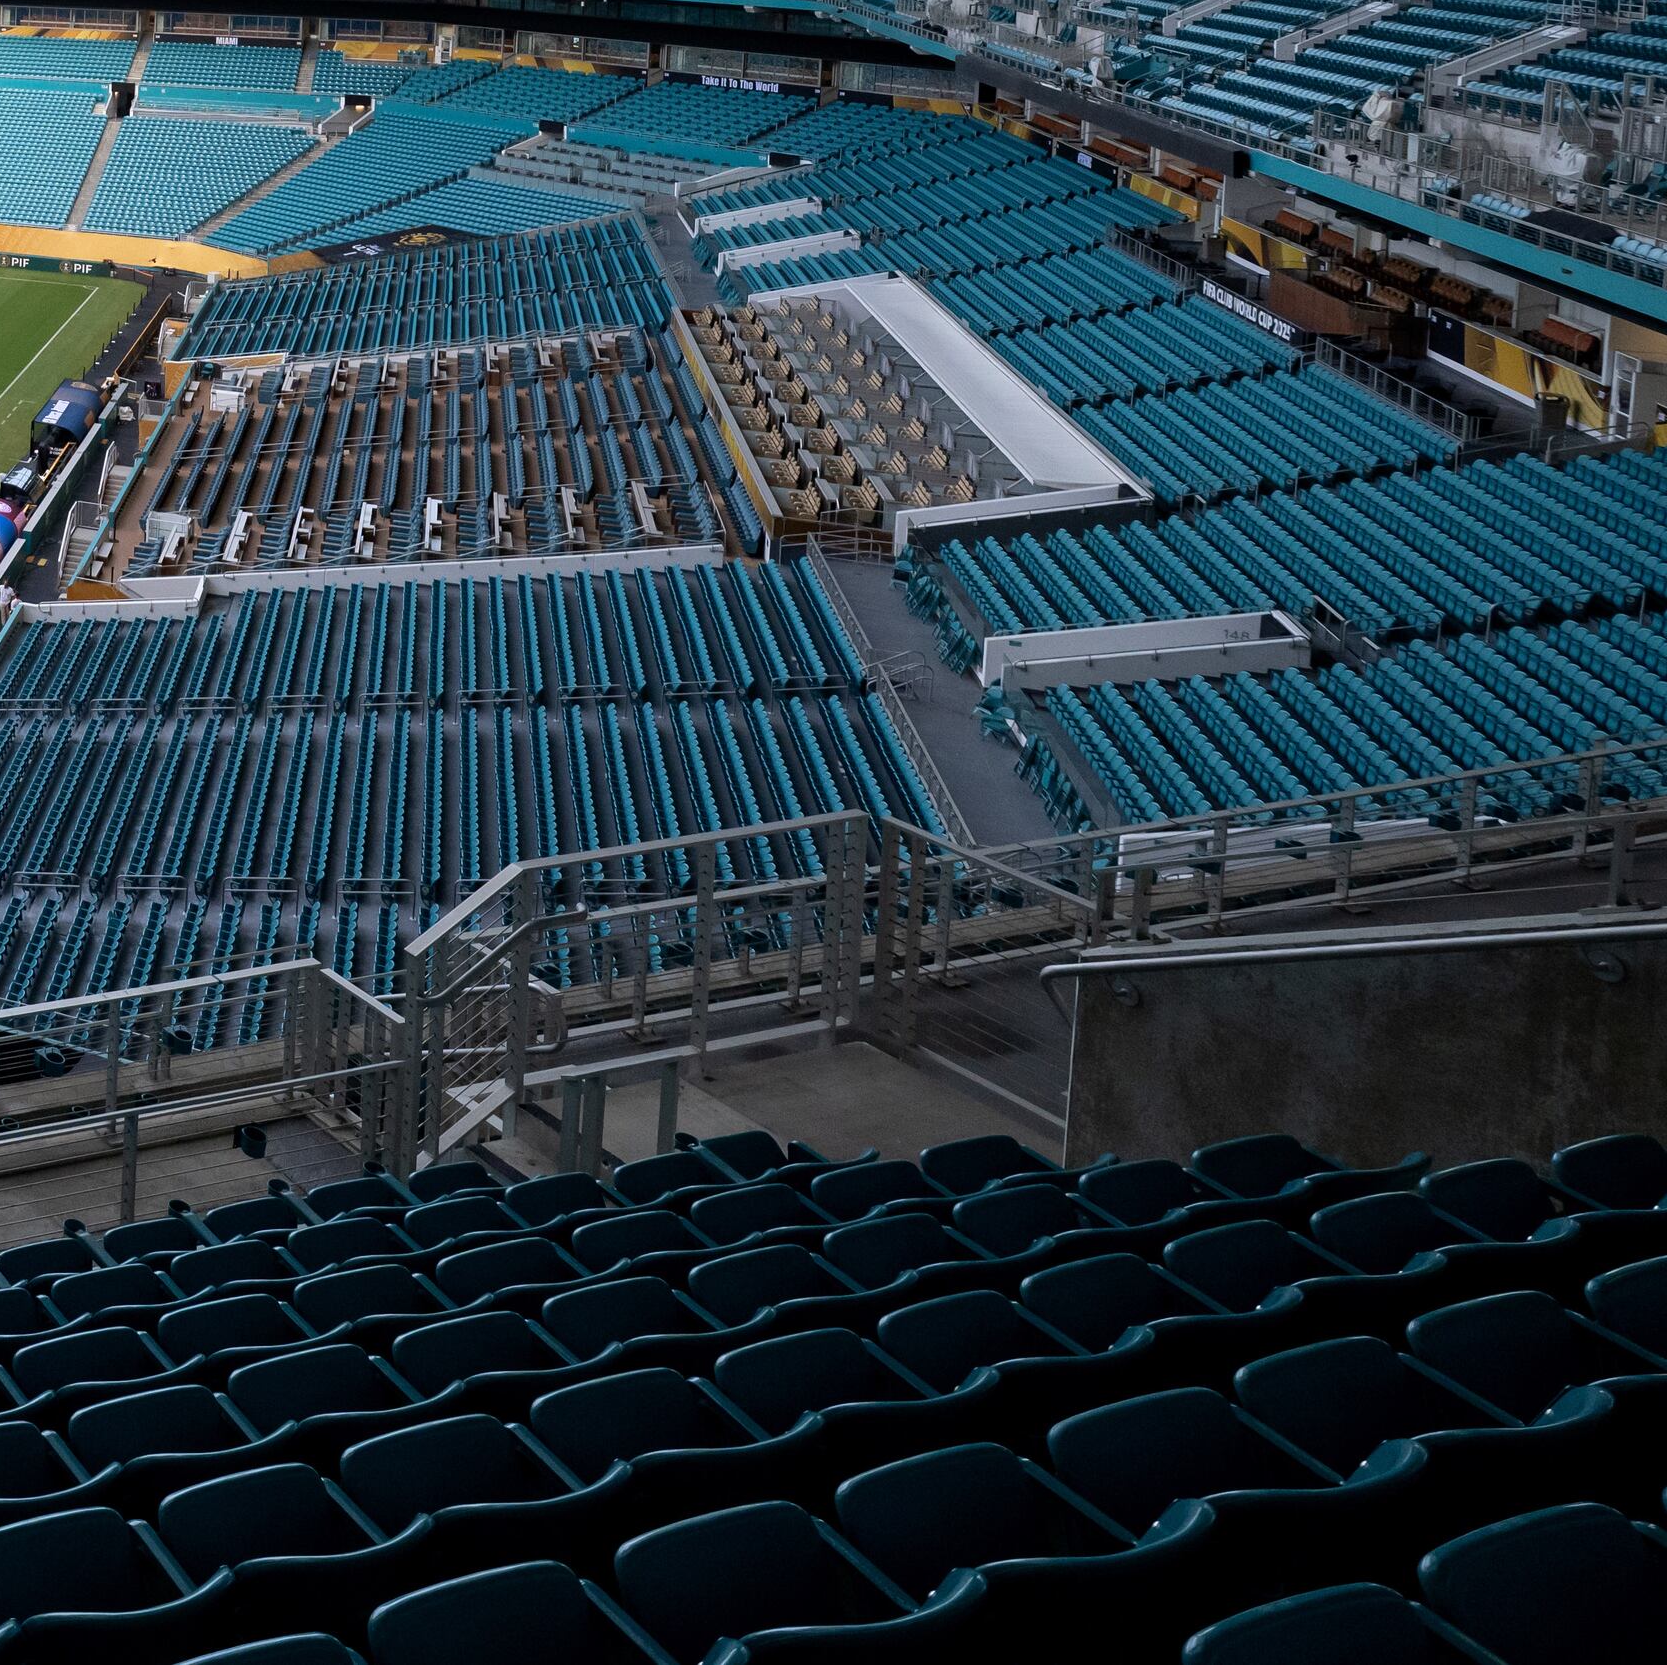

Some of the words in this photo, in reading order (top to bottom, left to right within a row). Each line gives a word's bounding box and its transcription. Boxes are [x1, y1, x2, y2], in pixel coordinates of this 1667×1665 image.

[215, 36, 238, 45] MIAMI
[702, 75, 720, 87] Take
[720, 77, 727, 87] It
[729, 78, 737, 88] To
[740, 79, 753, 90] The
[755, 81, 779, 93] World
[11, 256, 30, 268] PIF
[74, 263, 93, 274] PIF
[1203, 280, 1217, 301] FIFA
[1216, 288, 1233, 310] CLUB
[1233, 295, 1258, 323] WORLD
[1258, 310, 1273, 330] CUP
